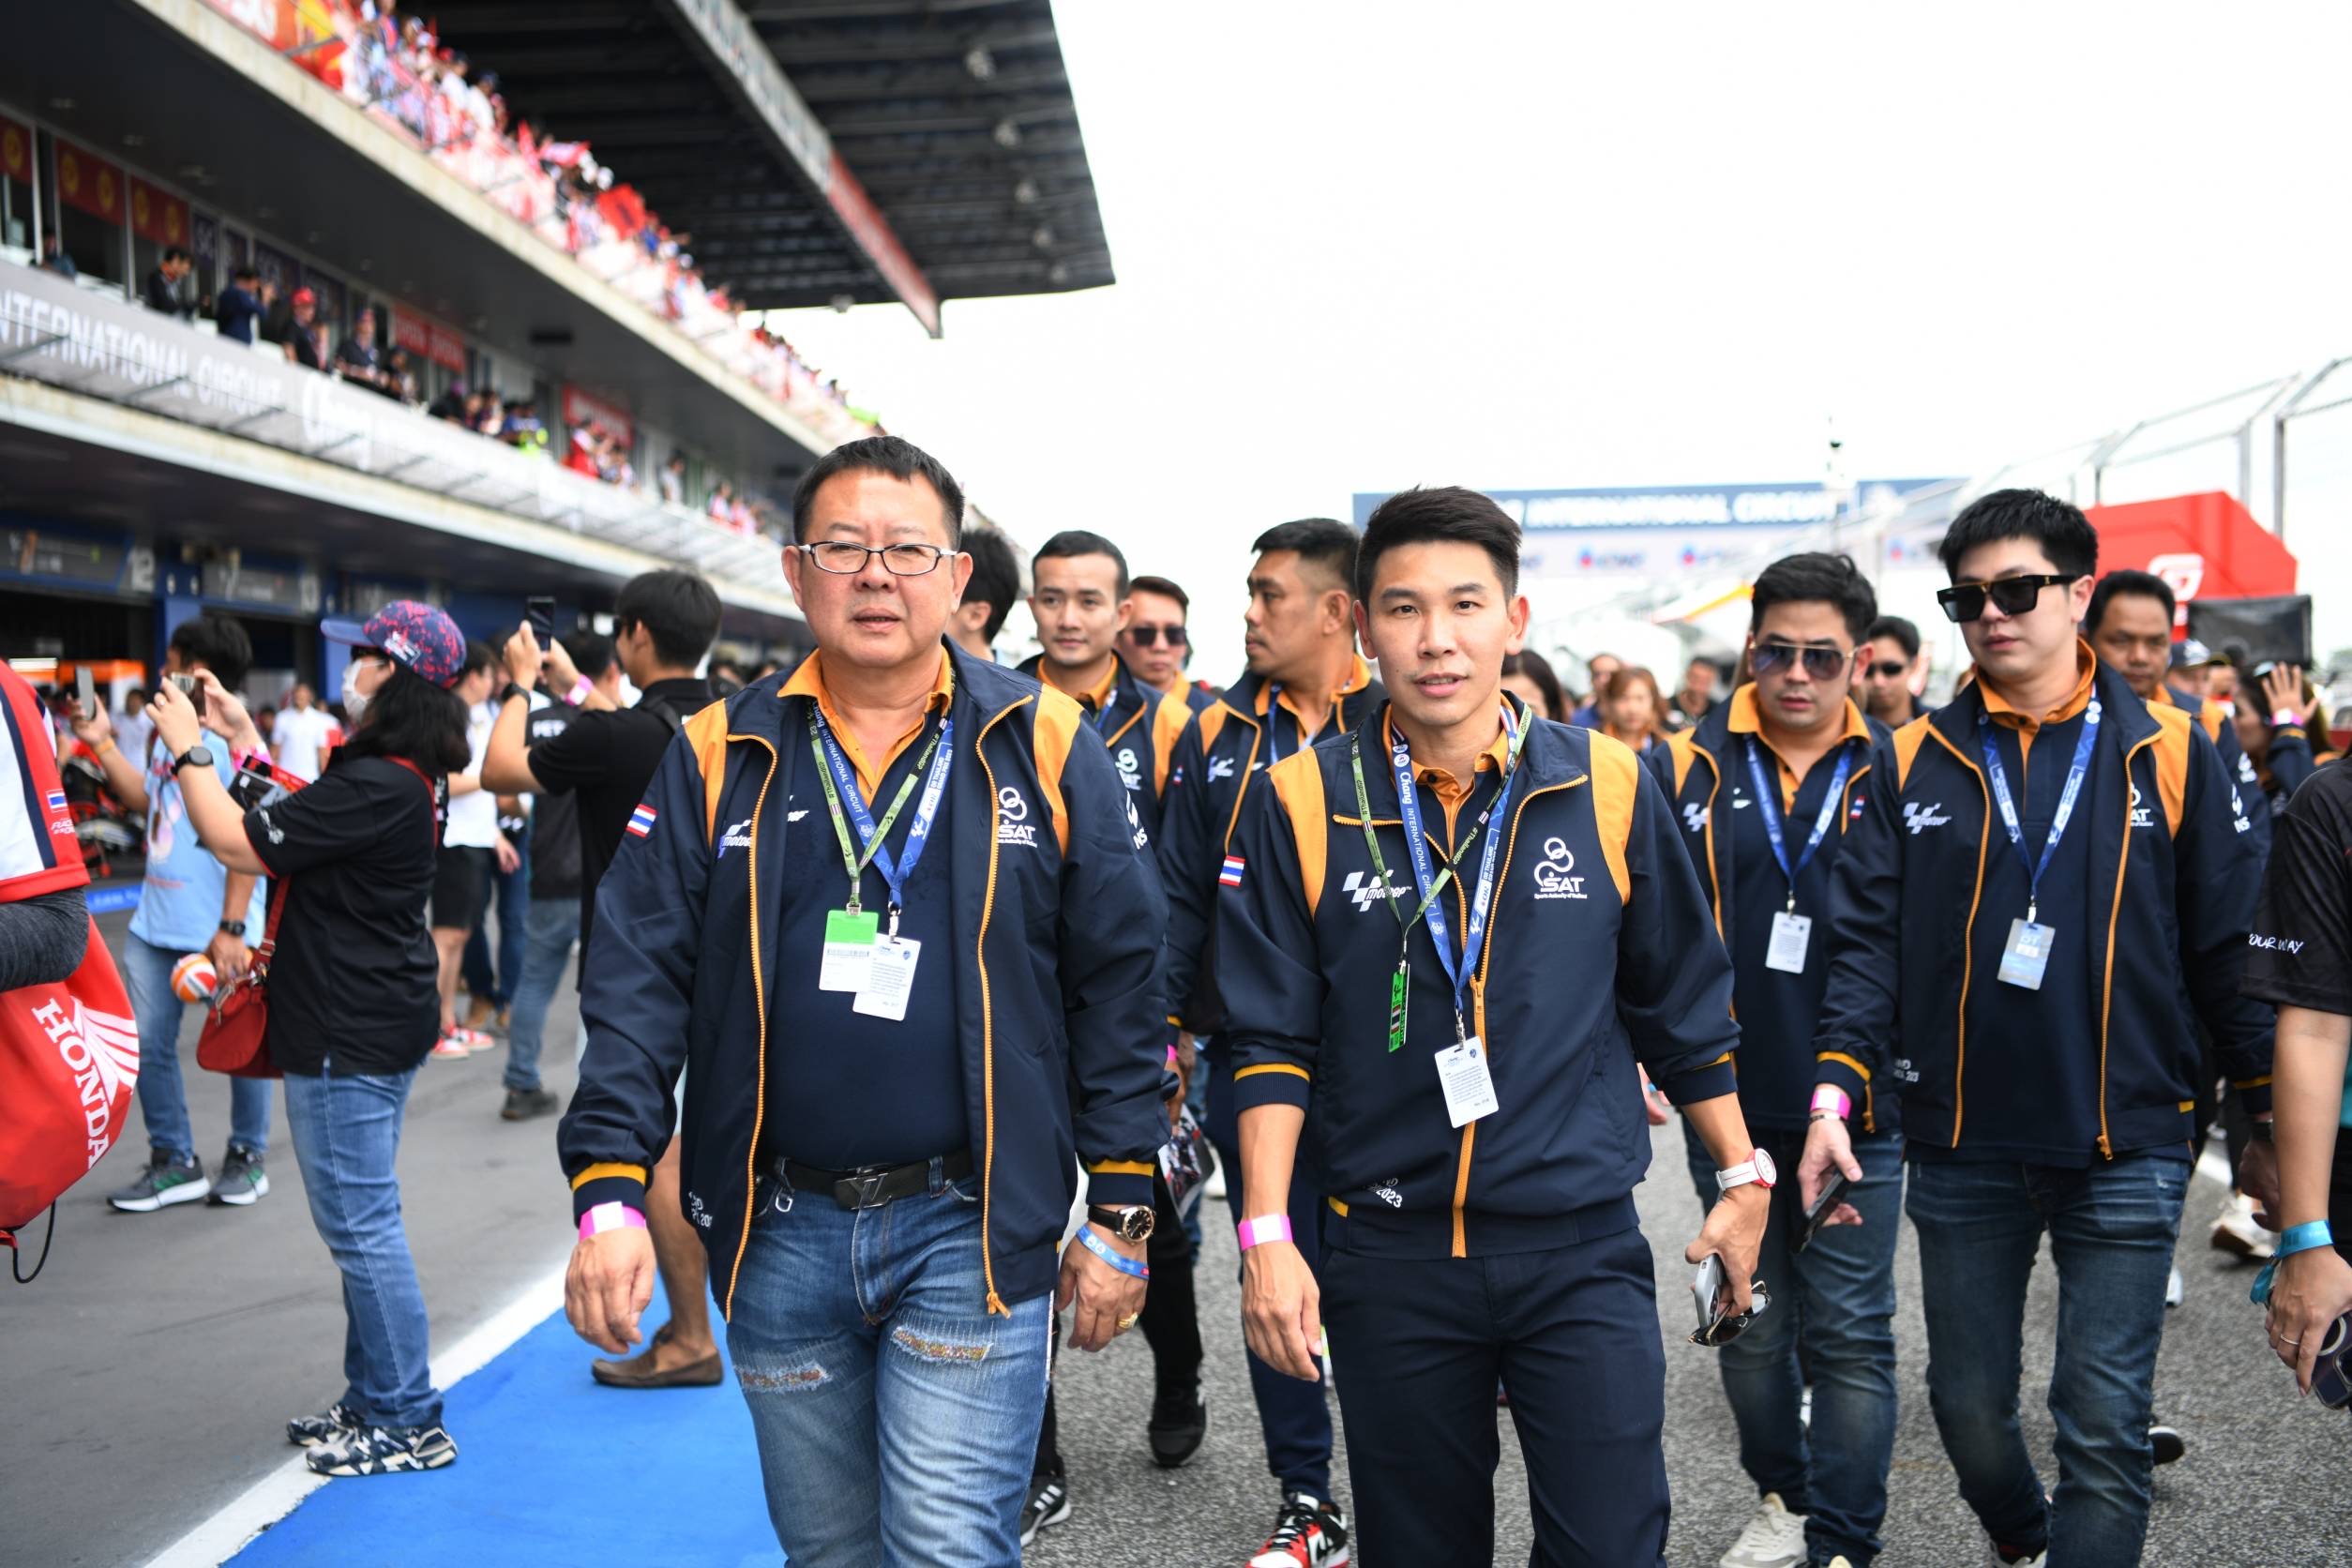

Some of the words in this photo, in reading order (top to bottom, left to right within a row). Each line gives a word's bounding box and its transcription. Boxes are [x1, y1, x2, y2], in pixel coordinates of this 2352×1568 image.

[1524, 493, 1731, 528] INTERNATIONAL
[916, 732, 940, 770] #ThailandGP
[818, 761, 836, 799] #ThailandGP
[822, 728, 849, 783] INTERNATIONAL
[844, 783, 864, 815] CIRCUIT
[1356, 779, 1368, 815] #ThailandGP
[997, 824, 1035, 840] SAT
[1399, 771, 1412, 805] Chang
[1407, 807, 1427, 872] INTERNATIONAL
[1453, 826, 1479, 865] #ThailandGP
[1485, 846, 1494, 873] THAILAND
[1541, 877, 1585, 893] SAT
[2277, 938, 2304, 955] WAY
[32, 998, 110, 1169] HONDA
